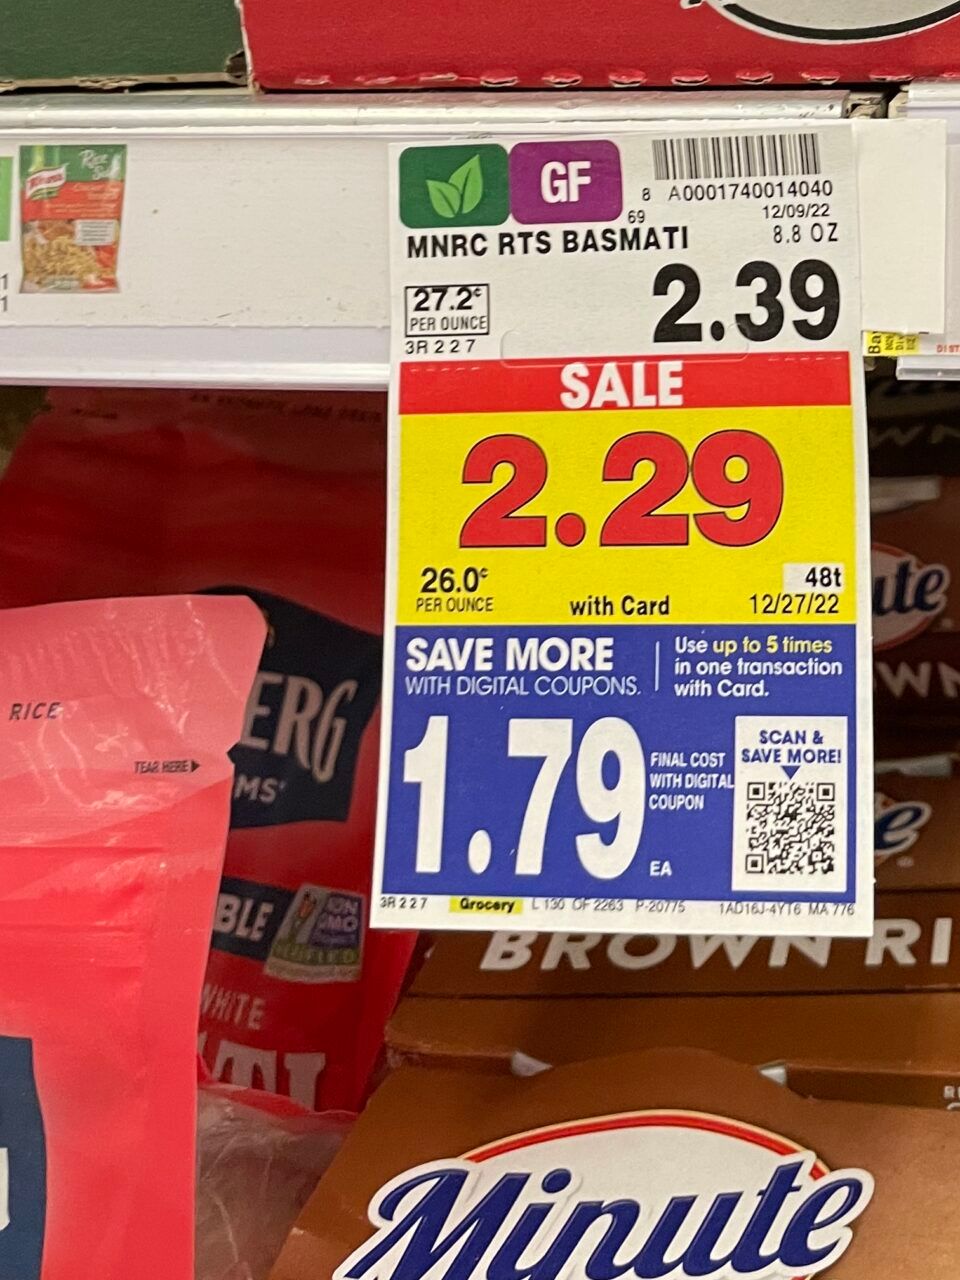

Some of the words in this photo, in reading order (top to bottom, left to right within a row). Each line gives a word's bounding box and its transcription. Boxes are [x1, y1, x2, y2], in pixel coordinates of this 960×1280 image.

[540, 160, 593, 205] GF
[668, 180, 834, 201] A0001740014040
[627, 209, 646, 224] 69
[762, 203, 831, 220] 12/09/22
[407, 235, 488, 258] MNRC
[499, 231, 552, 255] RTS
[562, 226, 689, 254] BASMATI
[772, 224, 802, 244] 8.8
[810, 222, 839, 242] OZ
[652, 259, 842, 343] 2.39
[409, 316, 437, 332] PER
[440, 314, 488, 331] OUNCE
[404, 338, 430, 356] 3R
[560, 360, 685, 410] SALE
[459, 428, 784, 548] 2.29
[804, 566, 843, 588] 48t
[416, 596, 444, 613] PER
[447, 595, 495, 612] OUNCE
[569, 595, 616, 616] with
[621, 594, 671, 616] Card
[750, 593, 841, 615] 12/27/22
[405, 637, 495, 672] SAVE
[506, 636, 615, 672] MORE
[675, 636, 708, 654] Use
[712, 639, 738, 658] up
[742, 637, 763, 654] to
[766, 636, 778, 654] 5
[782, 636, 833, 654] times
[674, 658, 693, 676] in
[696, 661, 733, 677] one
[736, 658, 843, 677] transaction
[405, 675, 451, 696] WITH
[456, 675, 530, 696] DIGITAL
[534, 675, 642, 696] COUPONS.
[674, 679, 713, 698] with
[718, 679, 770, 698] Card.
[9, 702, 61, 721] RICE
[758, 729, 809, 746] SCAN
[811, 729, 825, 746] &
[162, 760, 190, 774] HERE
[650, 751, 688, 769] FINAL
[691, 751, 726, 768] COST
[741, 748, 786, 765] SAVE
[787, 748, 842, 765] MORE!
[649, 773, 683, 789] WITH
[685, 772, 735, 789] DIGITAL
[403, 716, 646, 880] 1.79
[648, 793, 705, 811] COUPON
[649, 860, 673, 878] EA
[460, 898, 515, 914] Grocery
[480, 930, 828, 972] BROWN
[345, 1158, 862, 1280] Minute
